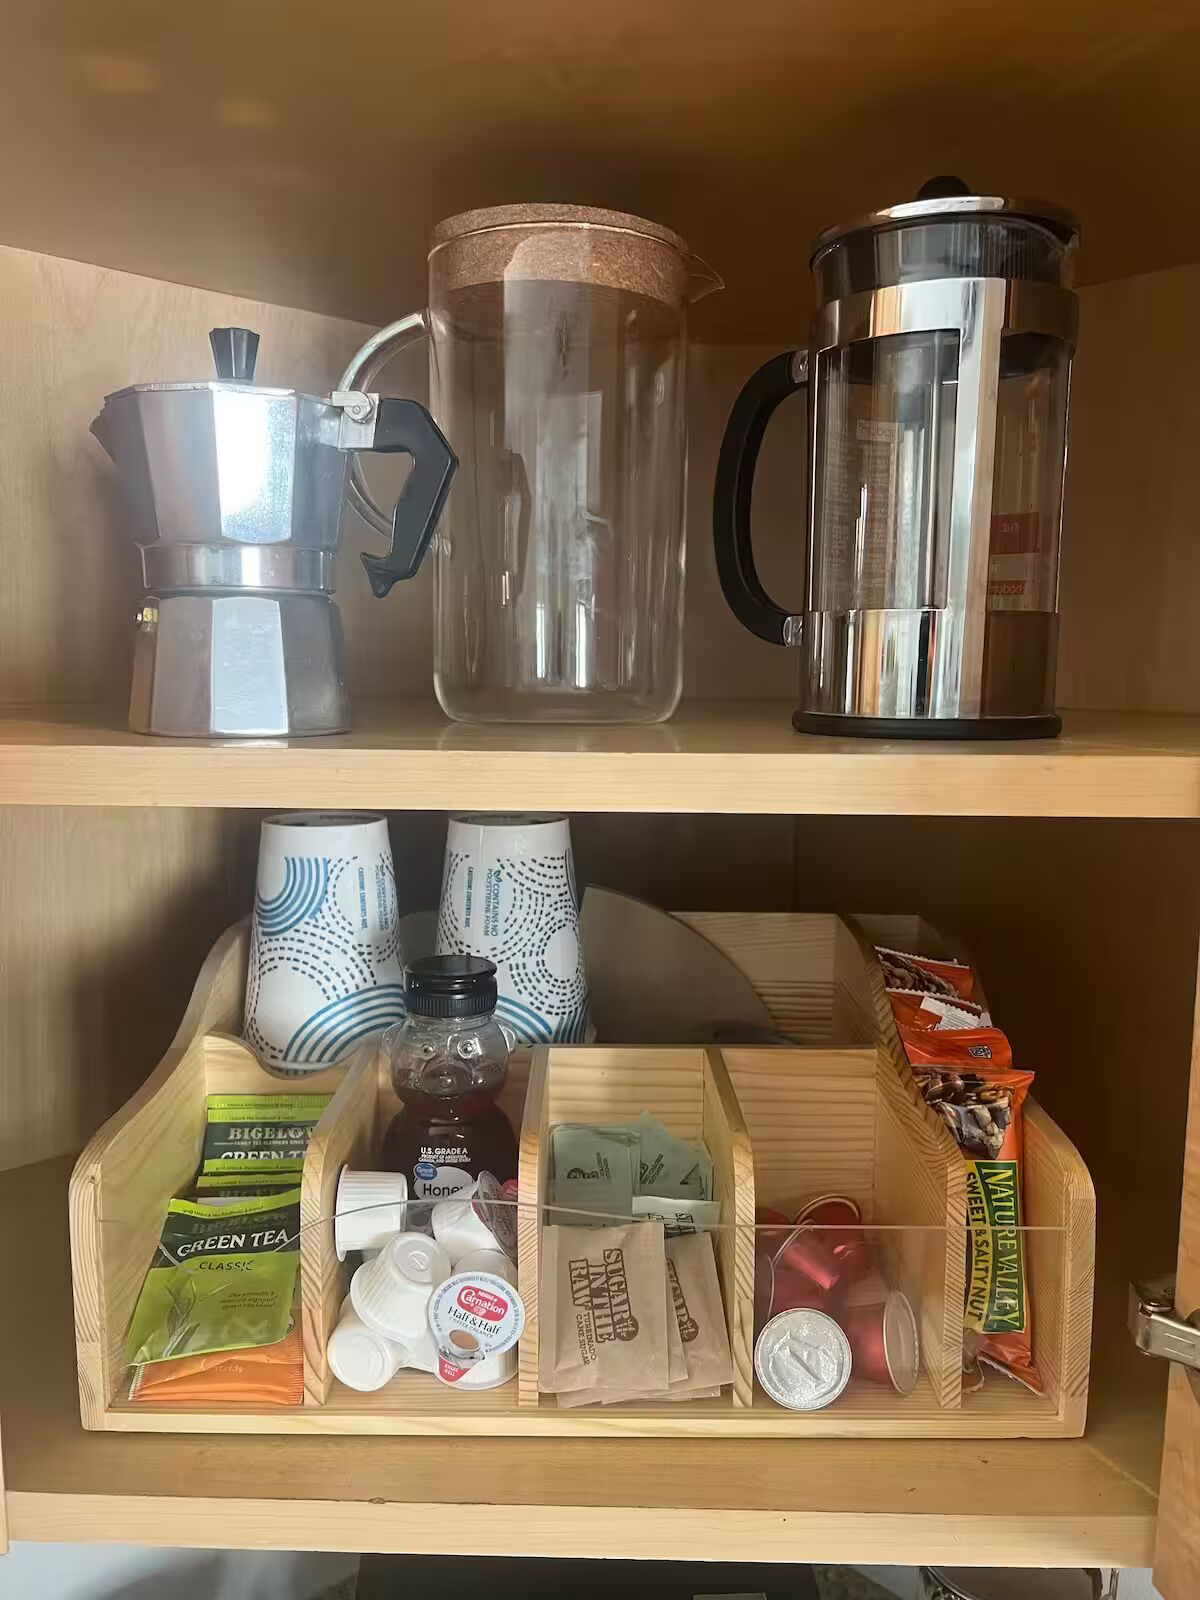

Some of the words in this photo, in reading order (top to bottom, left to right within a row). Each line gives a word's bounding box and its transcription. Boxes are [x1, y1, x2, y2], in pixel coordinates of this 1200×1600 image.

[484, 868, 493, 914] POLYSTYRENE
[491, 883, 500, 924] CONTAINS
[483, 915, 491, 937] FOAM
[490, 924, 498, 937] NO
[420, 1146, 434, 1155] U.S.
[434, 1147, 461, 1155] GRADE
[416, 1166, 434, 1174] Great
[423, 1183, 463, 1197] Hone
[966, 1172, 986, 1225] SWEET
[981, 1168, 1018, 1250] NATURE
[176, 1234, 245, 1257] GREEN
[250, 1228, 289, 1248] TEA
[974, 1229, 987, 1237] &
[199, 1260, 256, 1272] CLASSIC
[589, 1264, 609, 1288] IN
[972, 1239, 990, 1285] SALTY
[569, 1259, 593, 1306] RAW
[603, 1248, 633, 1324] SUGAR
[988, 1253, 1020, 1328] VALLEY
[460, 1288, 505, 1316] Carnation
[968, 1286, 987, 1322] NUT
[447, 1306, 470, 1323] Half
[469, 1317, 478, 1327] &
[478, 1319, 502, 1335] Half
[583, 1312, 597, 1360] TURBINADO
[579, 1340, 590, 1365] SUGAR
